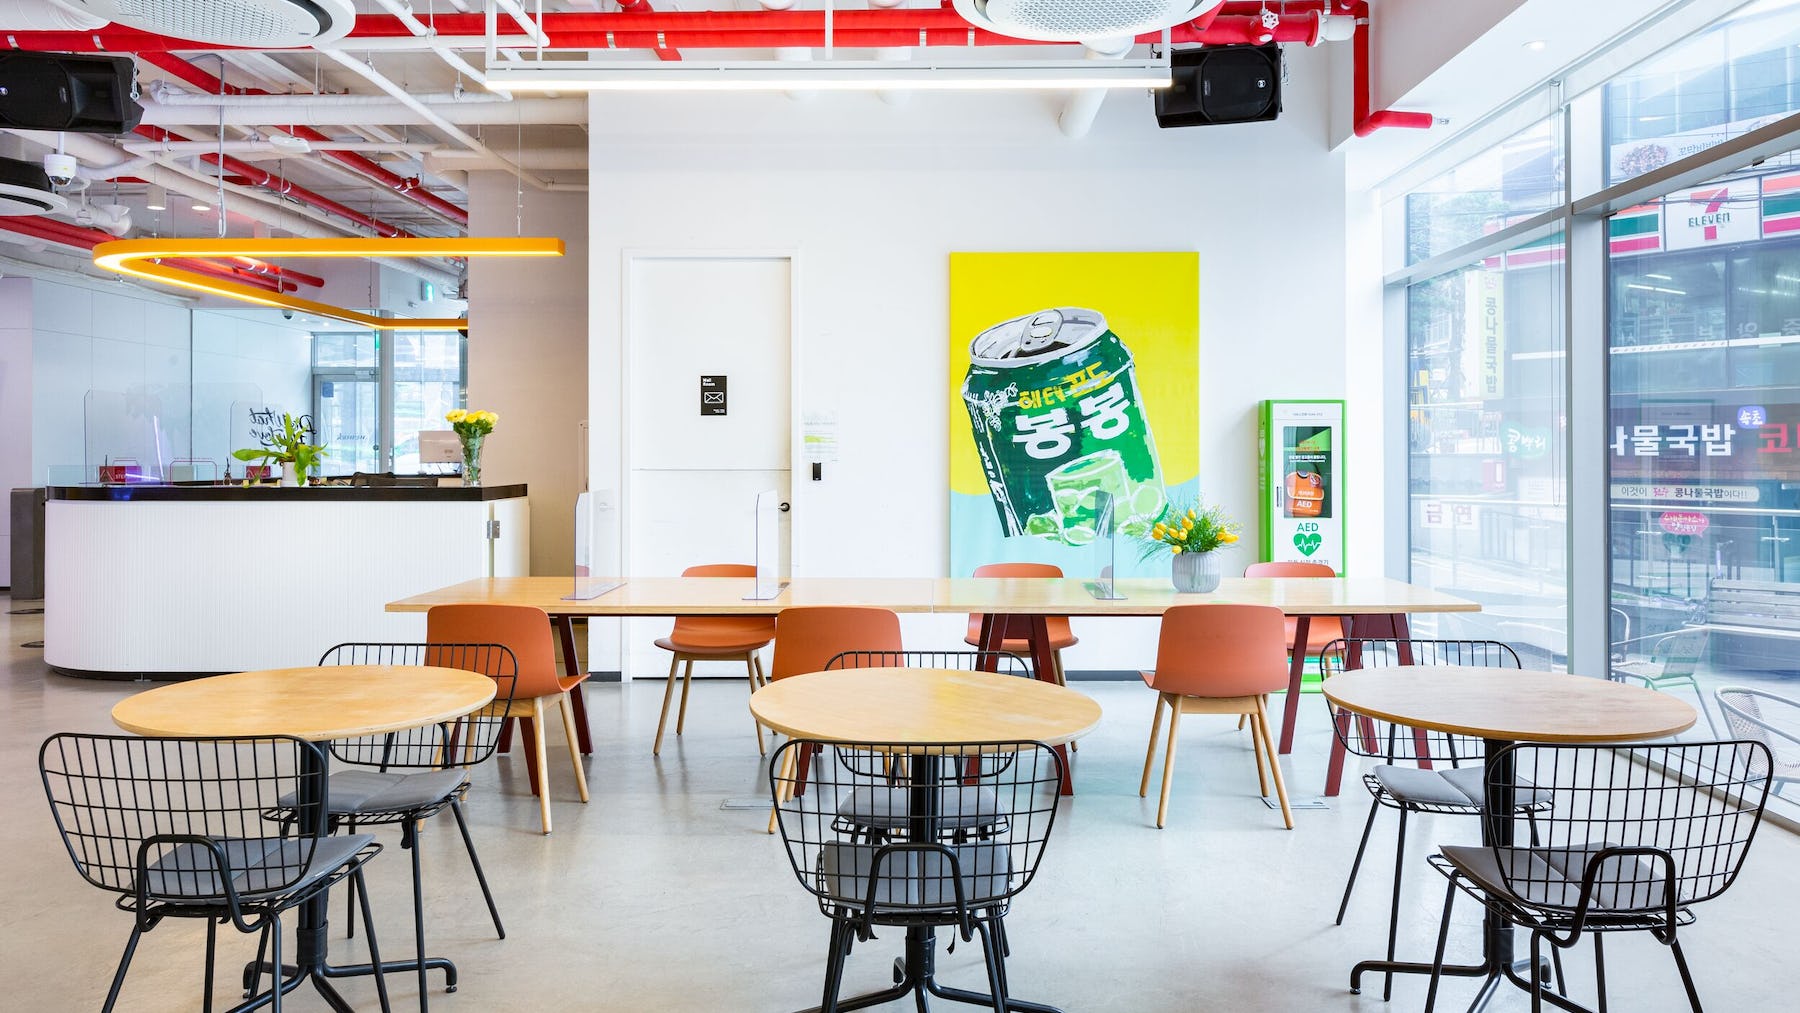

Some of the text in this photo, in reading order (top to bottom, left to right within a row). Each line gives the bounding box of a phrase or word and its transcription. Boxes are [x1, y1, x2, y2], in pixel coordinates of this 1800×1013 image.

[1757, 422, 1800, 453] 코
[1621, 485, 1648, 497] 이것이
[1297, 500, 1312, 508] AED
[1296, 522, 1319, 532] AED
